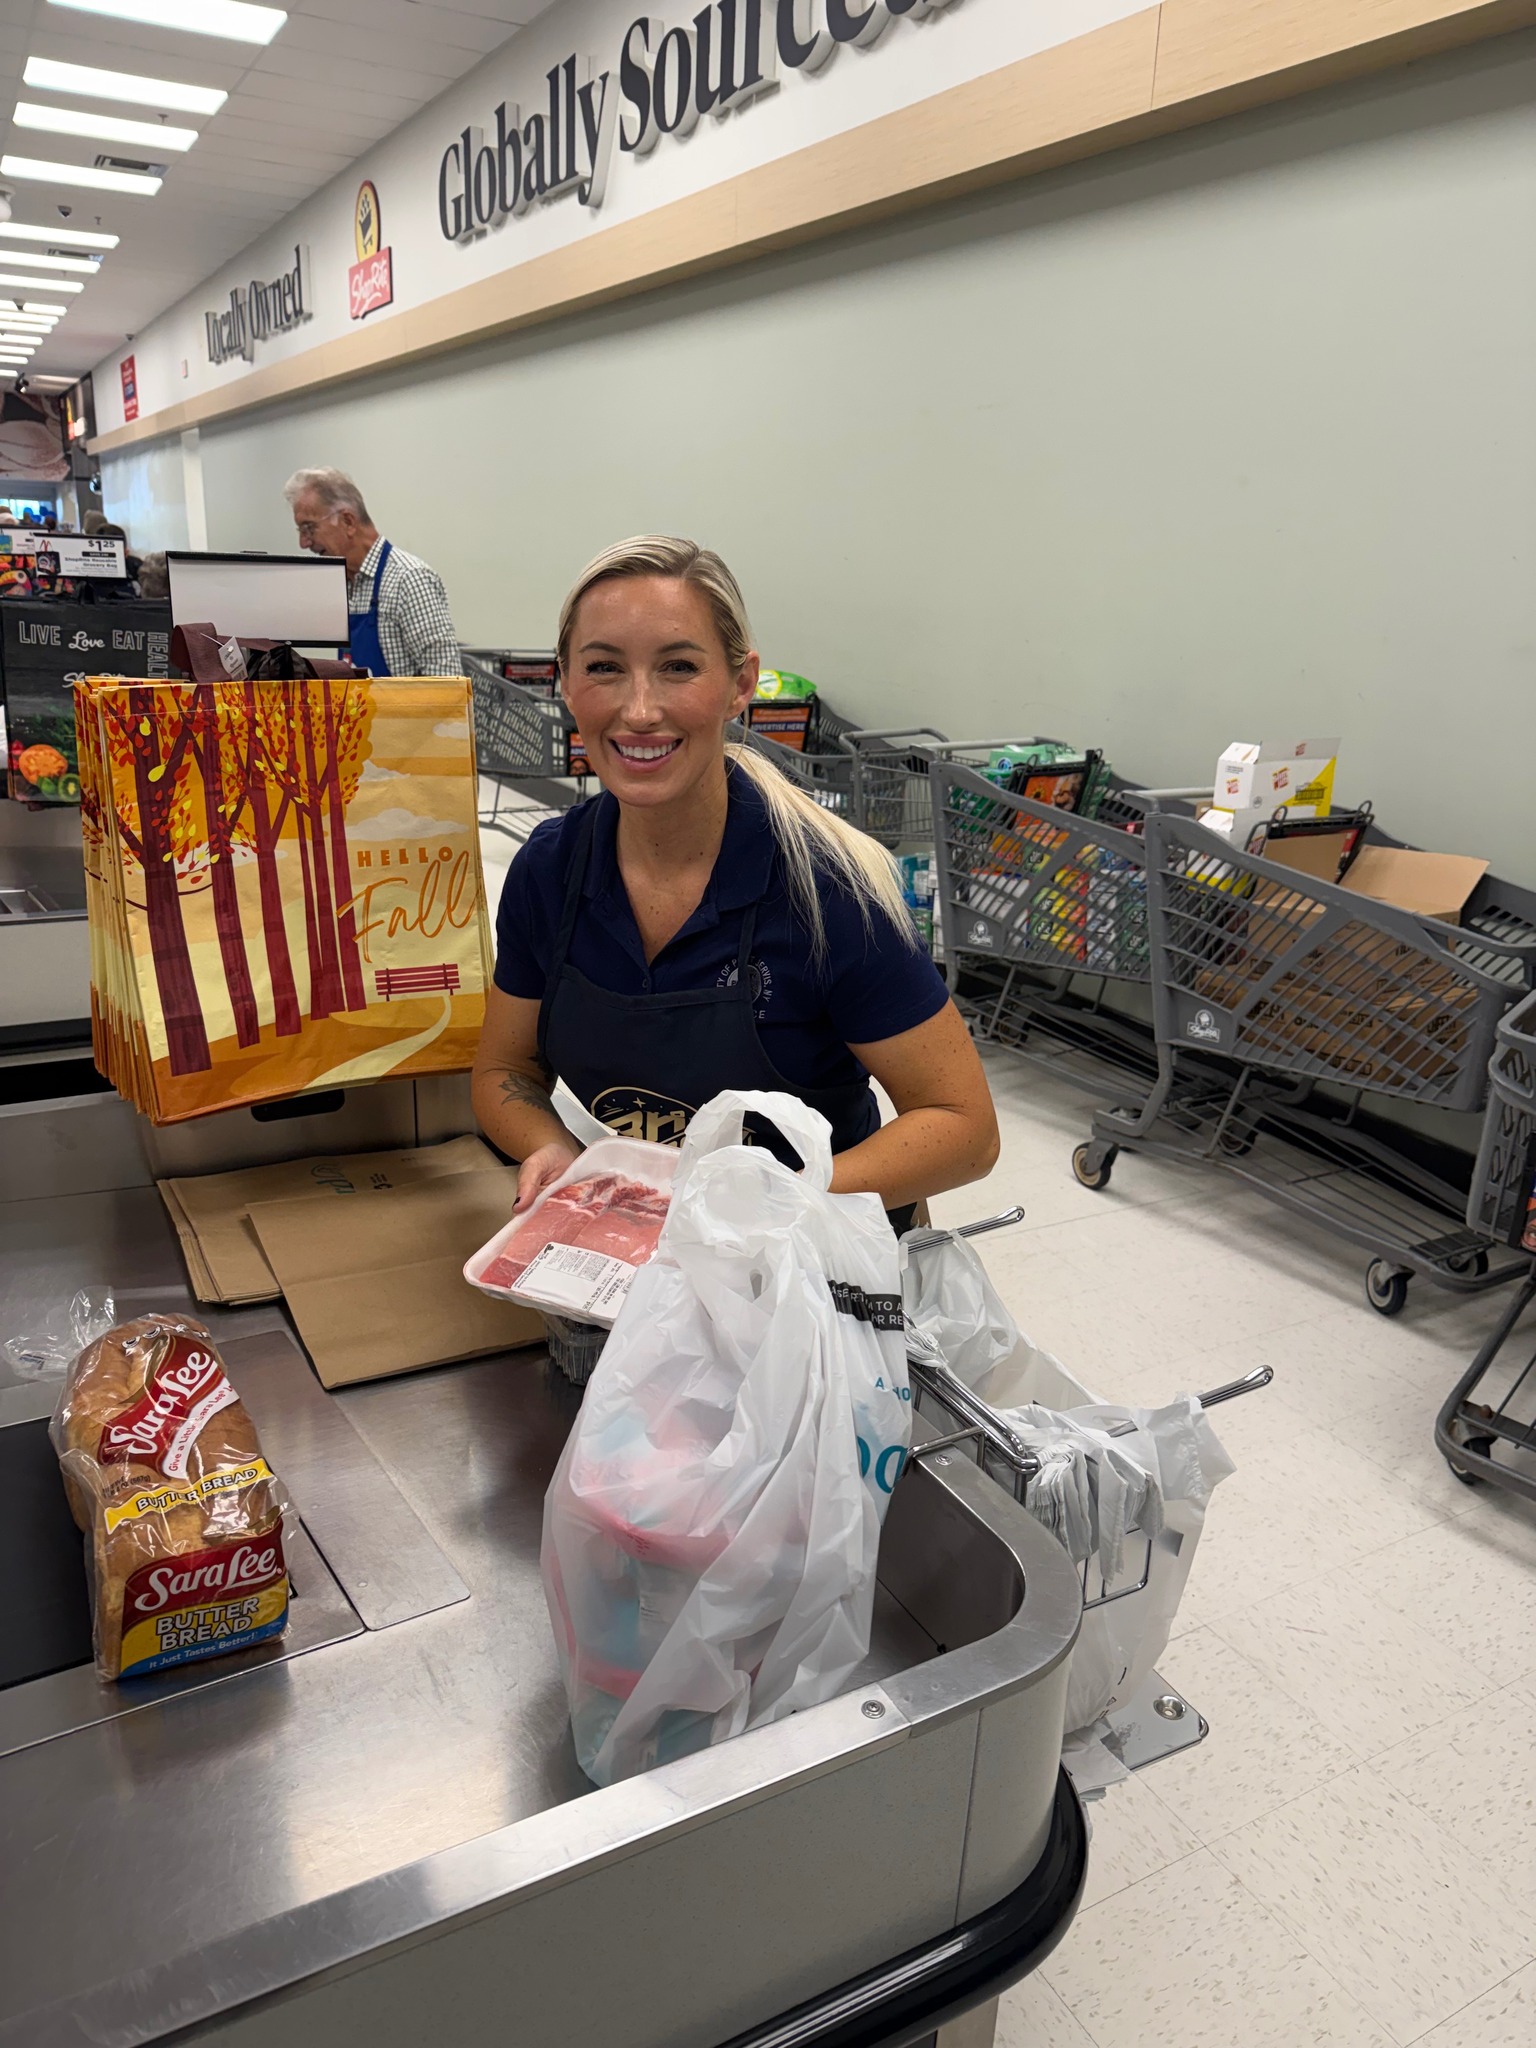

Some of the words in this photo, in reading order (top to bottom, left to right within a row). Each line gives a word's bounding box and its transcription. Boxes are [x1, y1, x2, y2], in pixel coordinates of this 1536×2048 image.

[438, 52, 610, 243] Globally
[205, 287, 254, 363] Locally
[249, 244, 304, 340] Owned
[351, 258, 388, 315] ShopRite
[19, 621, 61, 646] LIVE
[68, 631, 106, 651] Love
[112, 629, 146, 651] EAT
[147, 632, 169, 679] HEALT
[357, 846, 453, 868] HELLO
[336, 850, 480, 964] Fall
[875, 1300, 893, 1311] TO
[110, 1393, 182, 1455] Sara
[161, 1351, 218, 1401] Lee
[168, 1455, 182, 1472] Give
[201, 1468, 258, 1494] BREAD
[134, 1562, 226, 1612] Sara
[219, 1546, 278, 1592] Lee
[156, 1597, 260, 1636] BUTTER
[160, 1615, 253, 1652] BREAD
[149, 1659, 158, 1669] It
[159, 1653, 182, 1666] Just
[184, 1644, 216, 1658] Tastes
